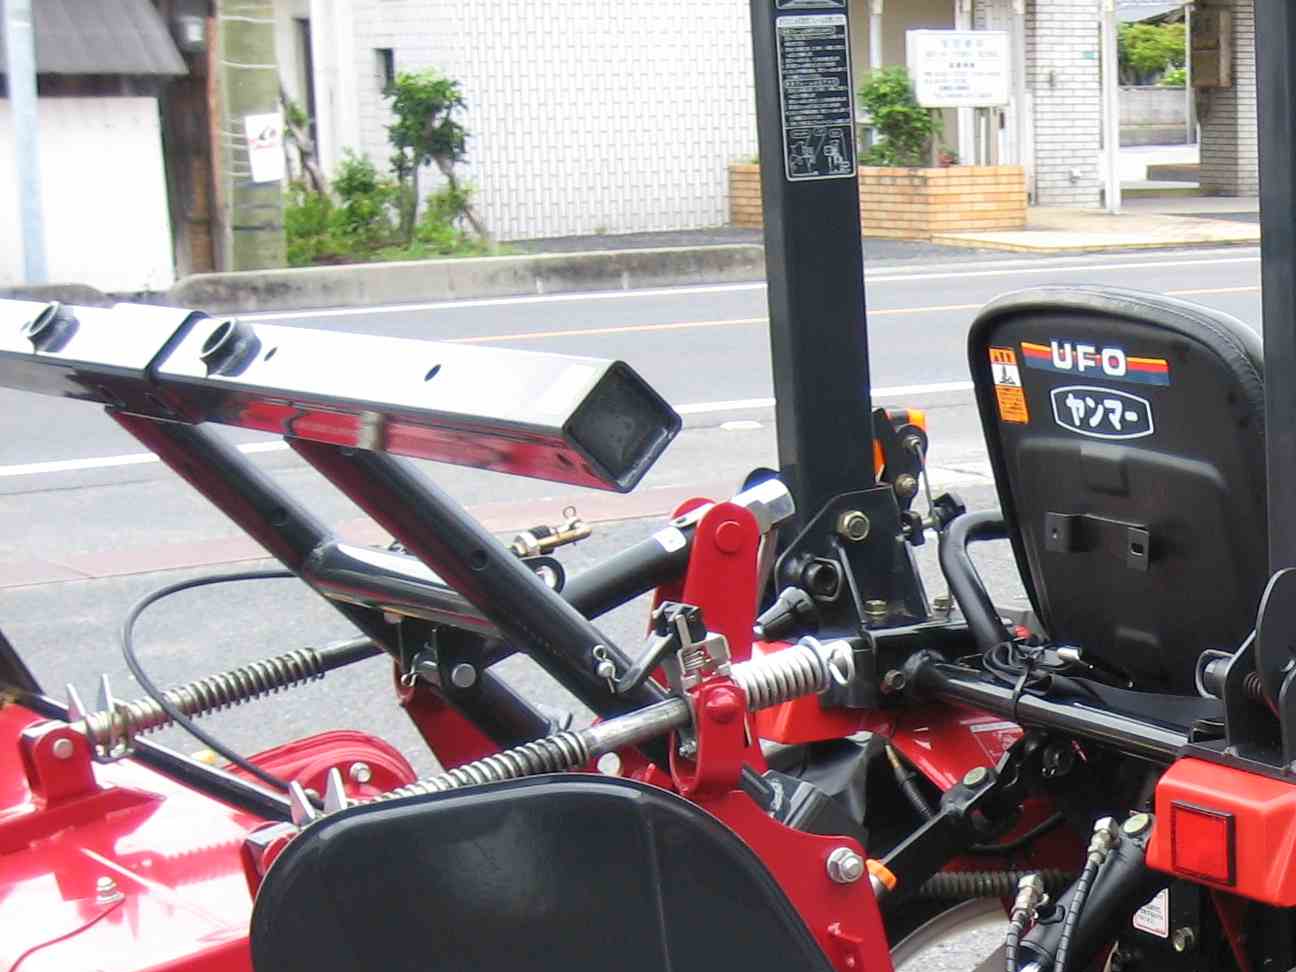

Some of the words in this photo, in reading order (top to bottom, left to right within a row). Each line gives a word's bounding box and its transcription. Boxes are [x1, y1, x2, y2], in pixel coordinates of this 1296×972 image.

[1050, 341, 1126, 376] UFO
[1065, 393, 1138, 430] ヤンマー
